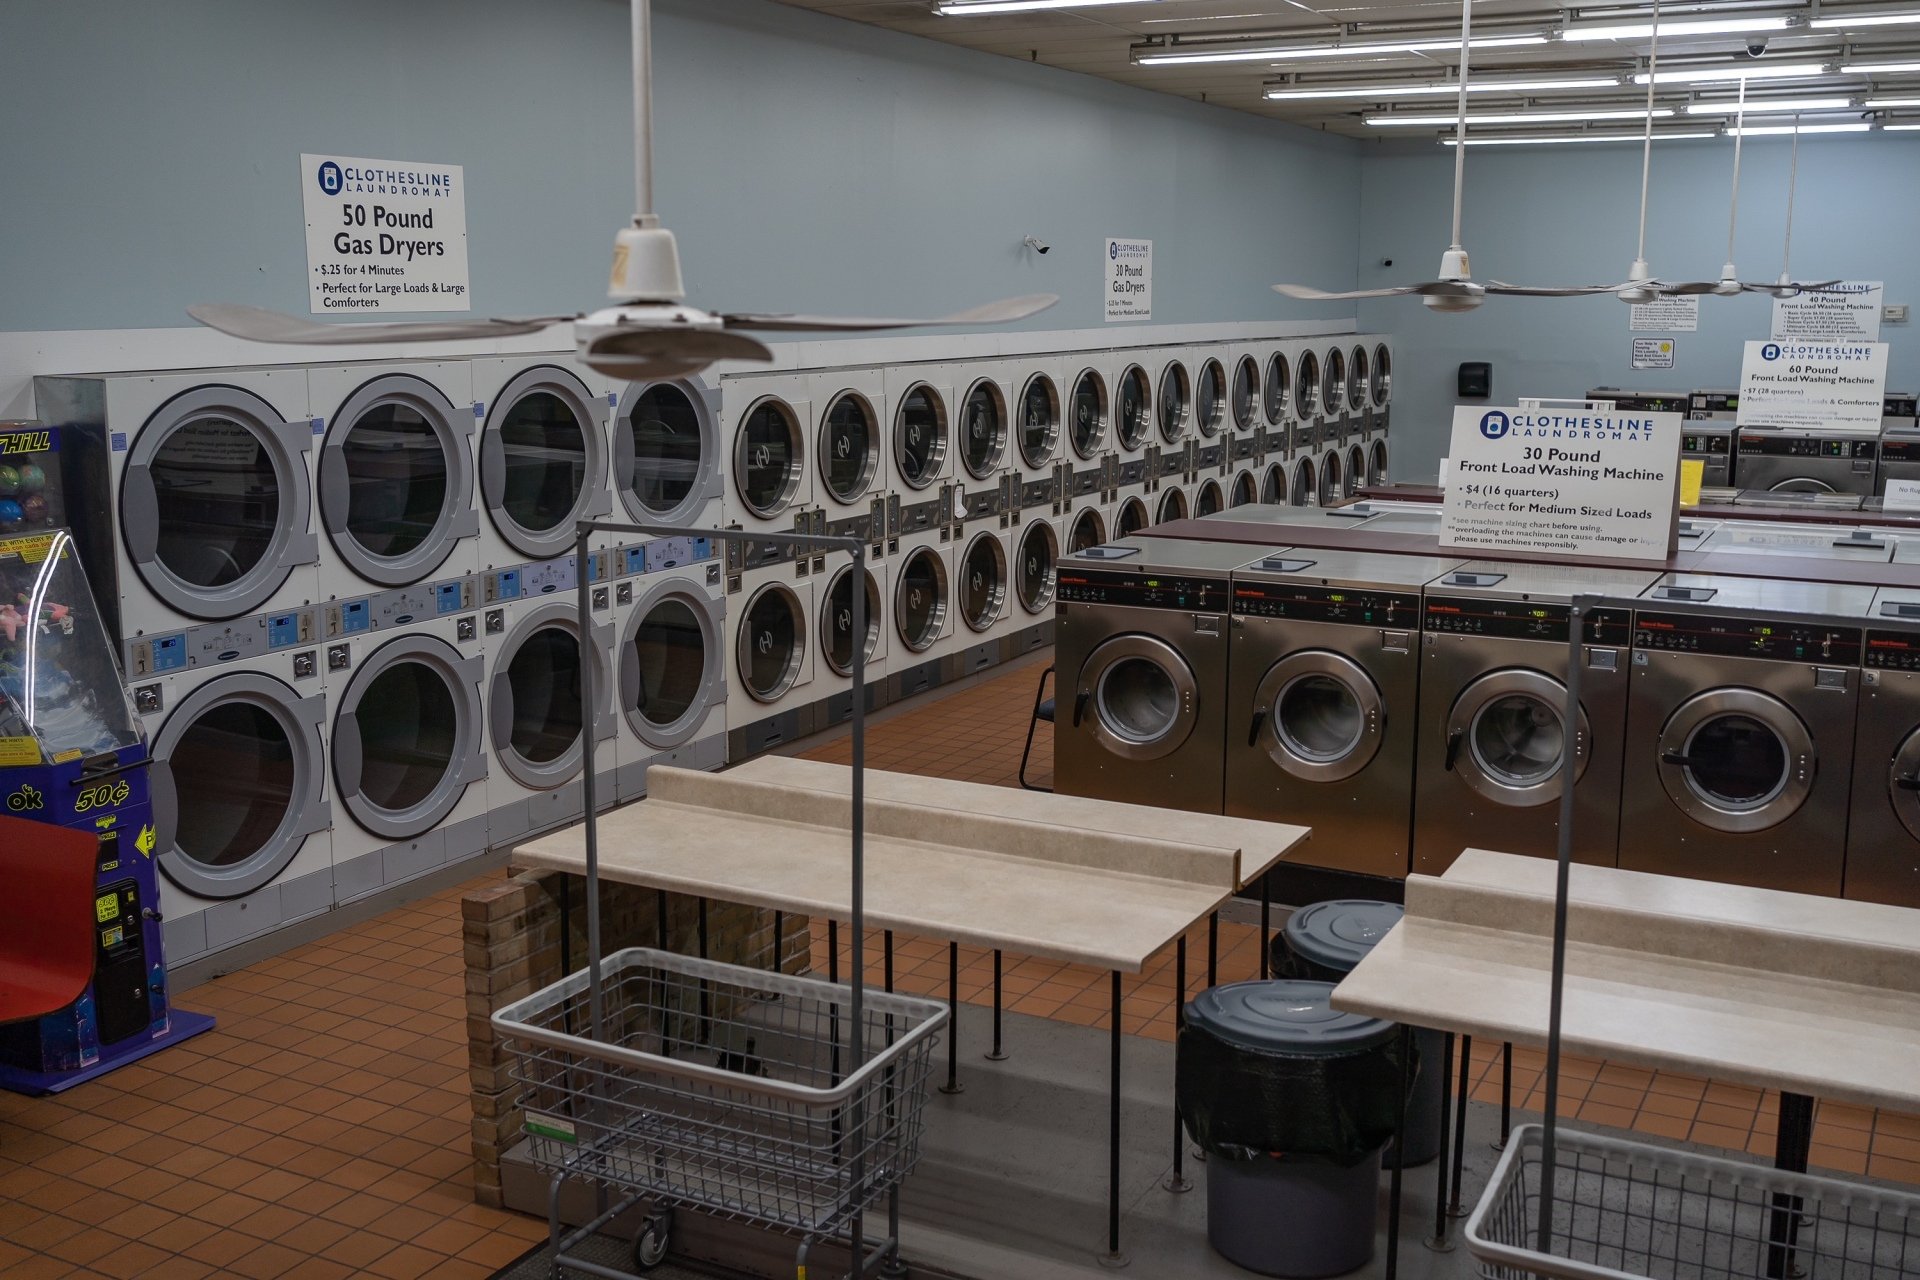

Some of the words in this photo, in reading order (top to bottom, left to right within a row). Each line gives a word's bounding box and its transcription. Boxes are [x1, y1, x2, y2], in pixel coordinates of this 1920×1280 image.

[345, 168, 450, 187] CLOTHESLINE
[346, 182, 450, 197] LAUNDROMAT
[343, 204, 366, 227] 50
[374, 205, 433, 228] Pound
[334, 232, 372, 255] Gas
[380, 233, 444, 262] Dryers
[321, 264, 341, 276] $.25
[344, 264, 358, 275] for
[360, 265, 366, 275] 4
[368, 264, 404, 276] Minutes
[1116, 264, 1123, 276] 30
[1125, 264, 1142, 276] Pound
[322, 283, 356, 294] Perfect
[358, 283, 372, 293] for
[375, 283, 402, 296] Large
[404, 283, 430, 293] Loads
[432, 283, 438, 293] &
[441, 283, 465, 295] Large
[1113, 281, 1124, 292] Gas
[1126, 281, 1145, 295] Dryers
[323, 297, 380, 308] Comforters
[1782, 346, 1871, 355] CLOTHESLINE
[1805, 366, 1838, 374] Pound
[1799, 375, 1836, 384] Washing
[1512, 416, 1653, 431] CLOTHESLINE
[1512, 428, 1652, 441] LAUNDROMAT
[1523, 447, 1542, 460] 30
[1548, 448, 1600, 462] Pound
[1460, 460, 1498, 472] Front
[1502, 462, 1535, 474] Load
[1538, 464, 1599, 480] Washing
[1604, 467, 1664, 480] Machine
[1466, 484, 1479, 494] $4
[1482, 485, 1500, 496] (16
[1504, 488, 1559, 500] quarters)
[1464, 500, 1505, 511] Perfect
[1509, 502, 1525, 512] for
[1529, 504, 1576, 514] Medium
[1580, 506, 1612, 517] Sized
[1616, 508, 1652, 519] Loads
[1506, 520, 1527, 528] sizing
[1580, 525, 1603, 533] using.
[1495, 537, 1531, 546] machines
[1533, 540, 1578, 550] responsibly.
[1516, 530, 1552, 538] machines
[1595, 535, 1626, 544] damage
[75, 780, 129, 812] 50¢
